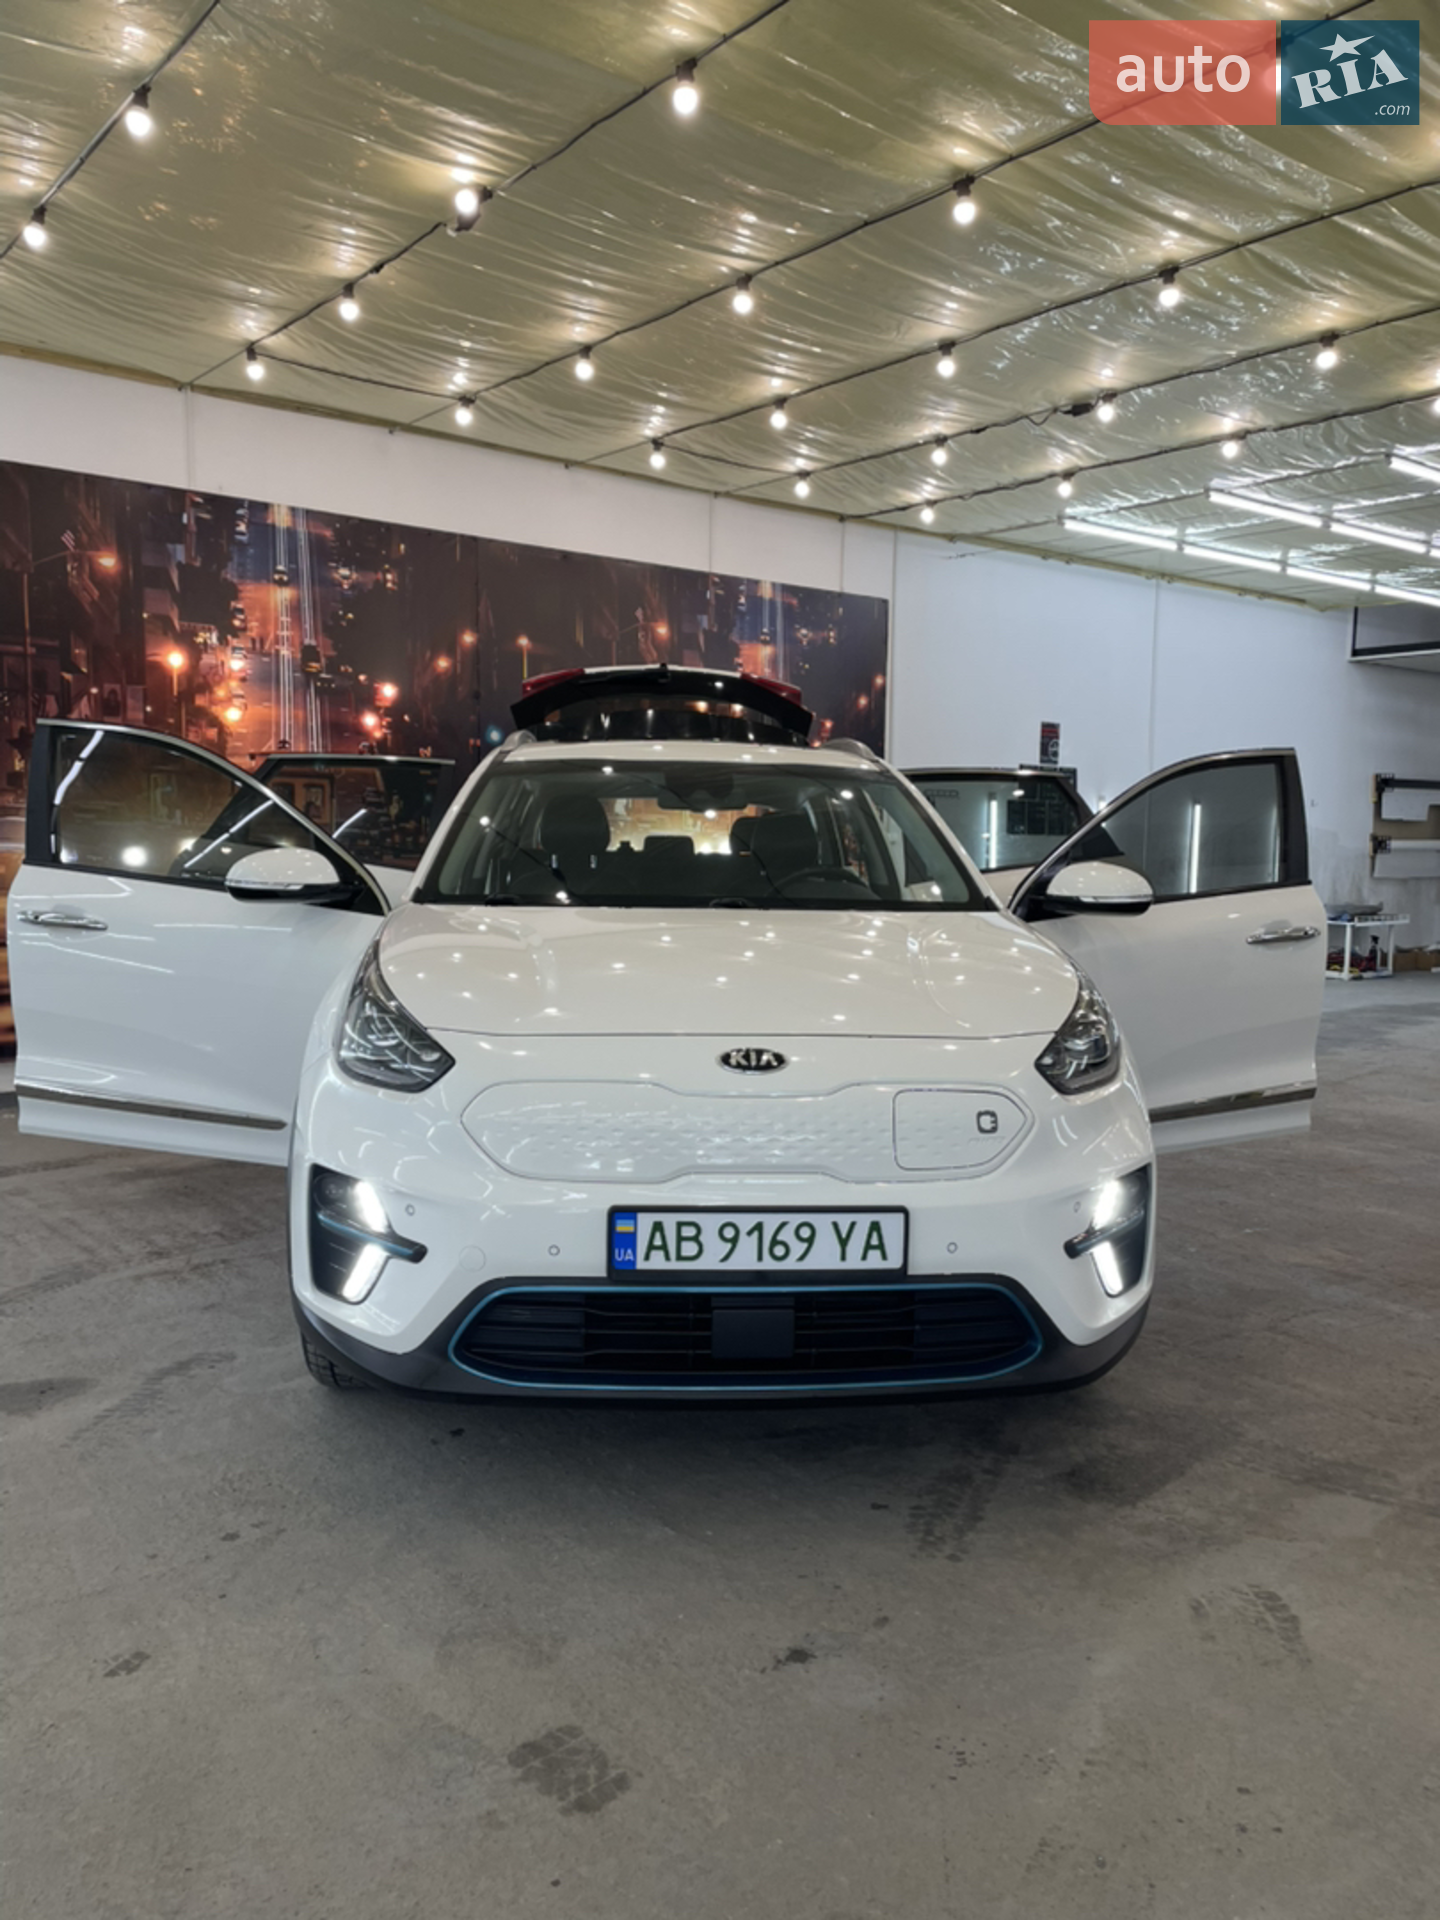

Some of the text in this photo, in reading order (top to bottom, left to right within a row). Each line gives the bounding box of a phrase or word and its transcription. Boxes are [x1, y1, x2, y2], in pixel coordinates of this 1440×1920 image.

[729, 1049, 778, 1067] KIA
[643, 1220, 888, 1263] AB 9169 YA
[614, 1248, 635, 1262] UA
